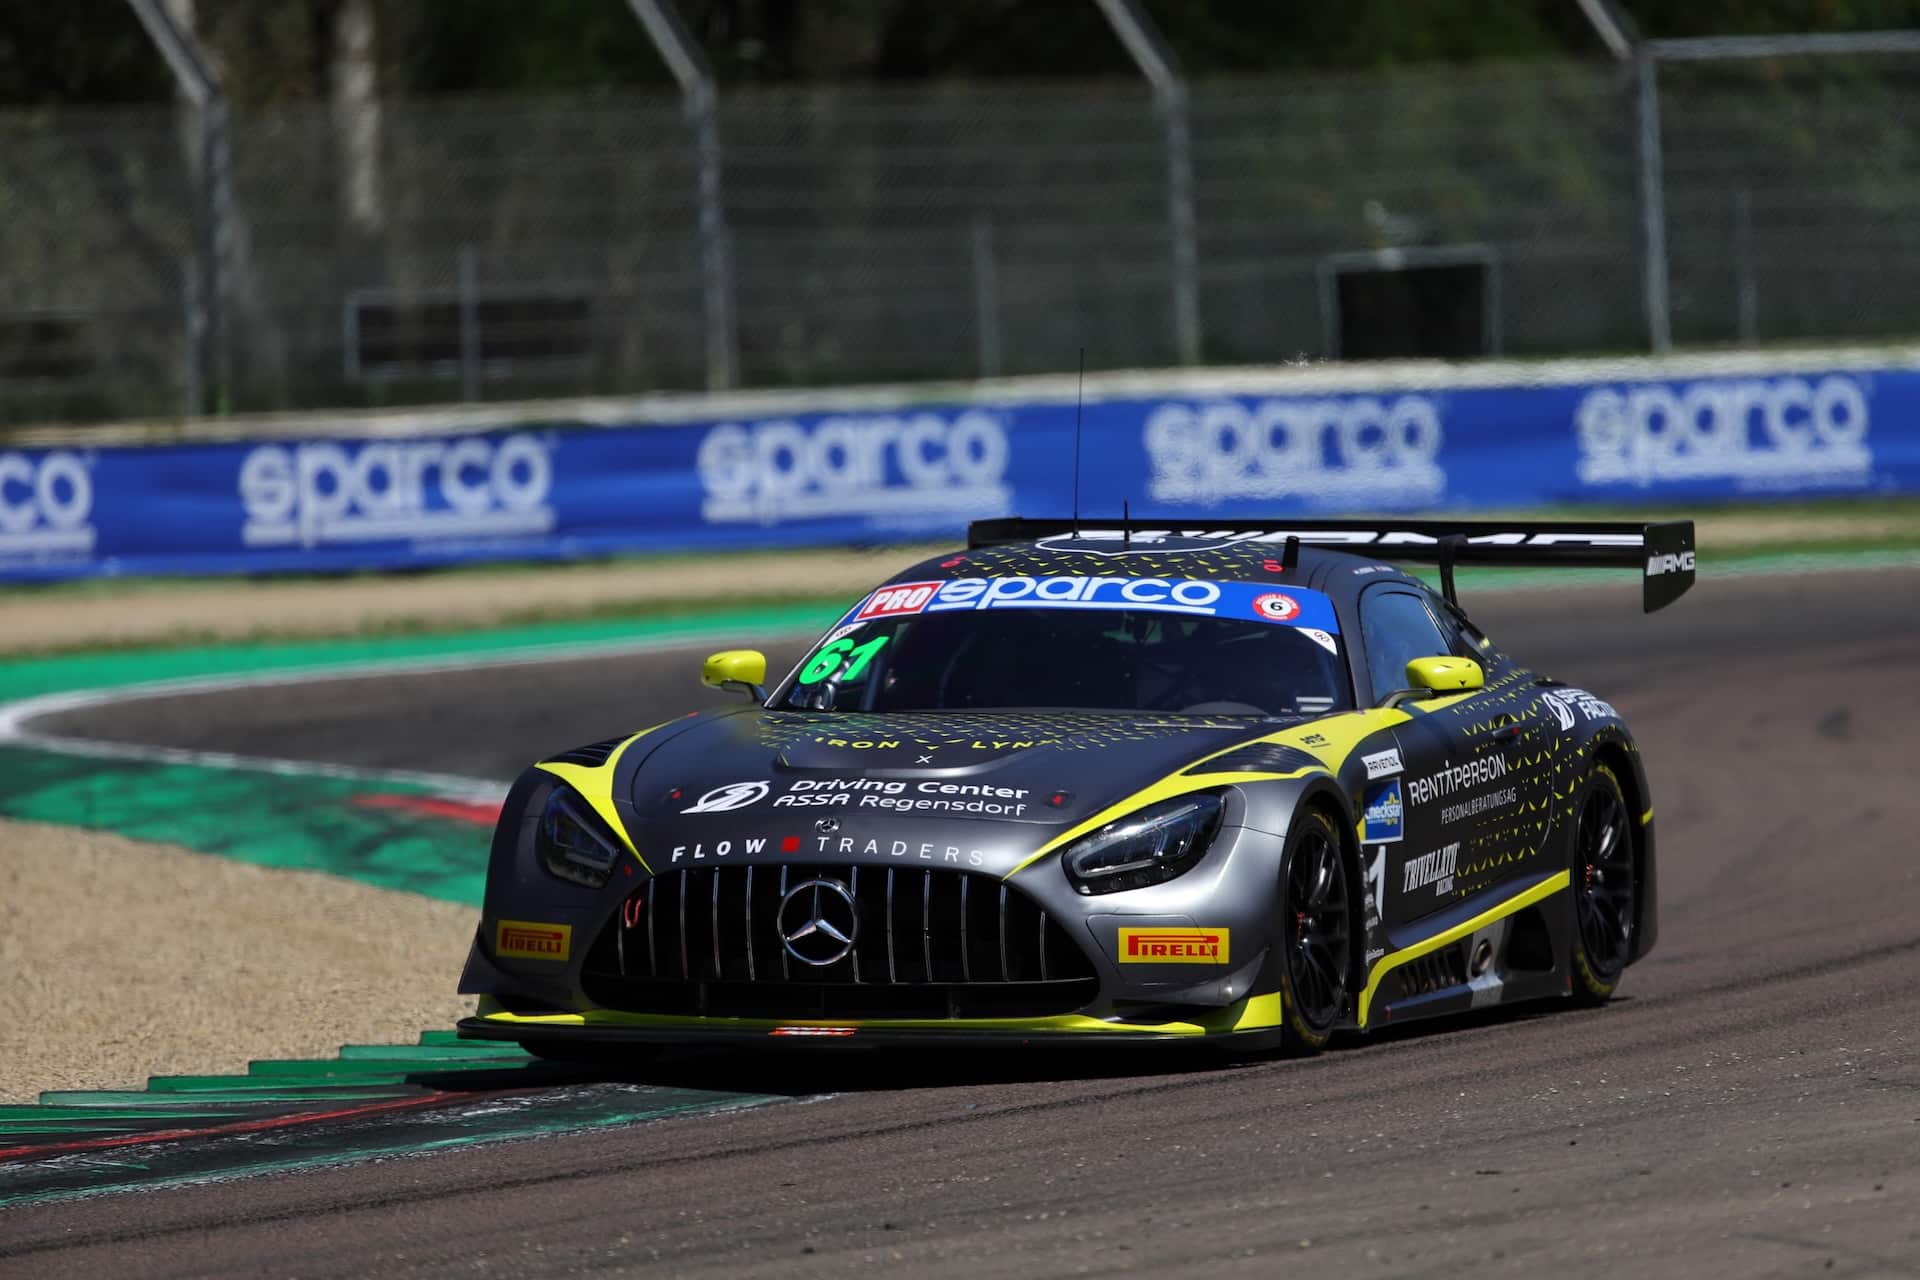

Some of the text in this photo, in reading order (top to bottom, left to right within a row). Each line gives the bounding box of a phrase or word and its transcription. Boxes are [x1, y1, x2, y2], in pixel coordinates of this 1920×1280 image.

[1576, 374, 1868, 487] sparco
[1144, 395, 1441, 508] sparco
[698, 410, 1008, 526] sparco
[238, 435, 551, 548] sparco
[1659, 551, 1695, 573] AMG
[864, 587, 932, 614] PRO
[939, 577, 1220, 609] sparco
[1270, 602, 1283, 611] 6
[799, 636, 890, 684] 61
[815, 737, 900, 749] IRON
[789, 779, 1029, 798] Driving Center
[773, 793, 1027, 816] ASSA Regensdorf
[671, 836, 983, 866] FLOW TRADERS
[501, 928, 564, 953] PIRELLI
[1128, 935, 1219, 956] PIRELLI
